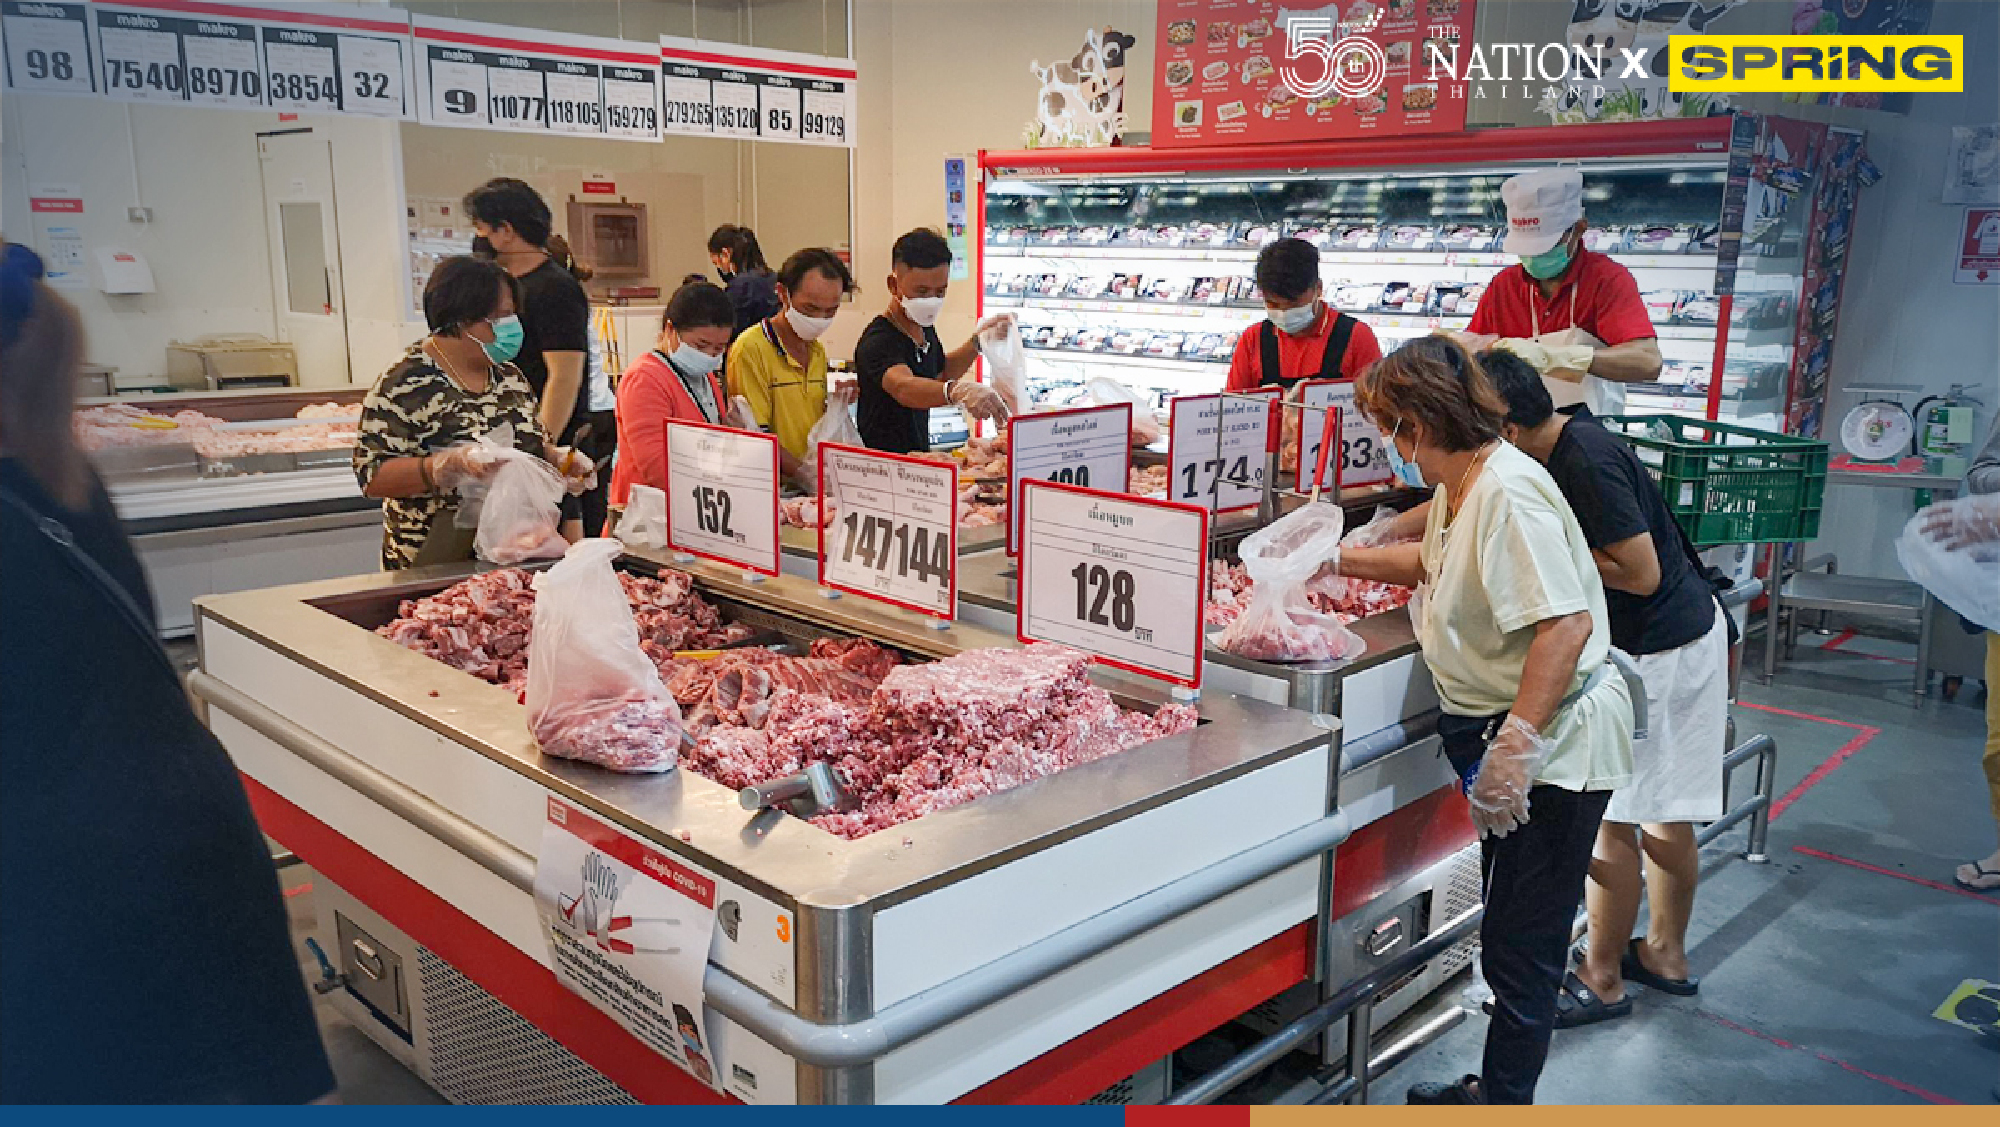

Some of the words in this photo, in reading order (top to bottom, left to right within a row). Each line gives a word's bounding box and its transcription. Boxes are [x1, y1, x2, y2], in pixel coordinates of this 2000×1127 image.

[27, 50, 73, 80] 98
[354, 72, 390, 98] 32
[445, 90, 477, 113] 9
[768, 108, 792, 132] 85
[693, 485, 733, 537] 152
[1072, 562, 1135, 632] 128
